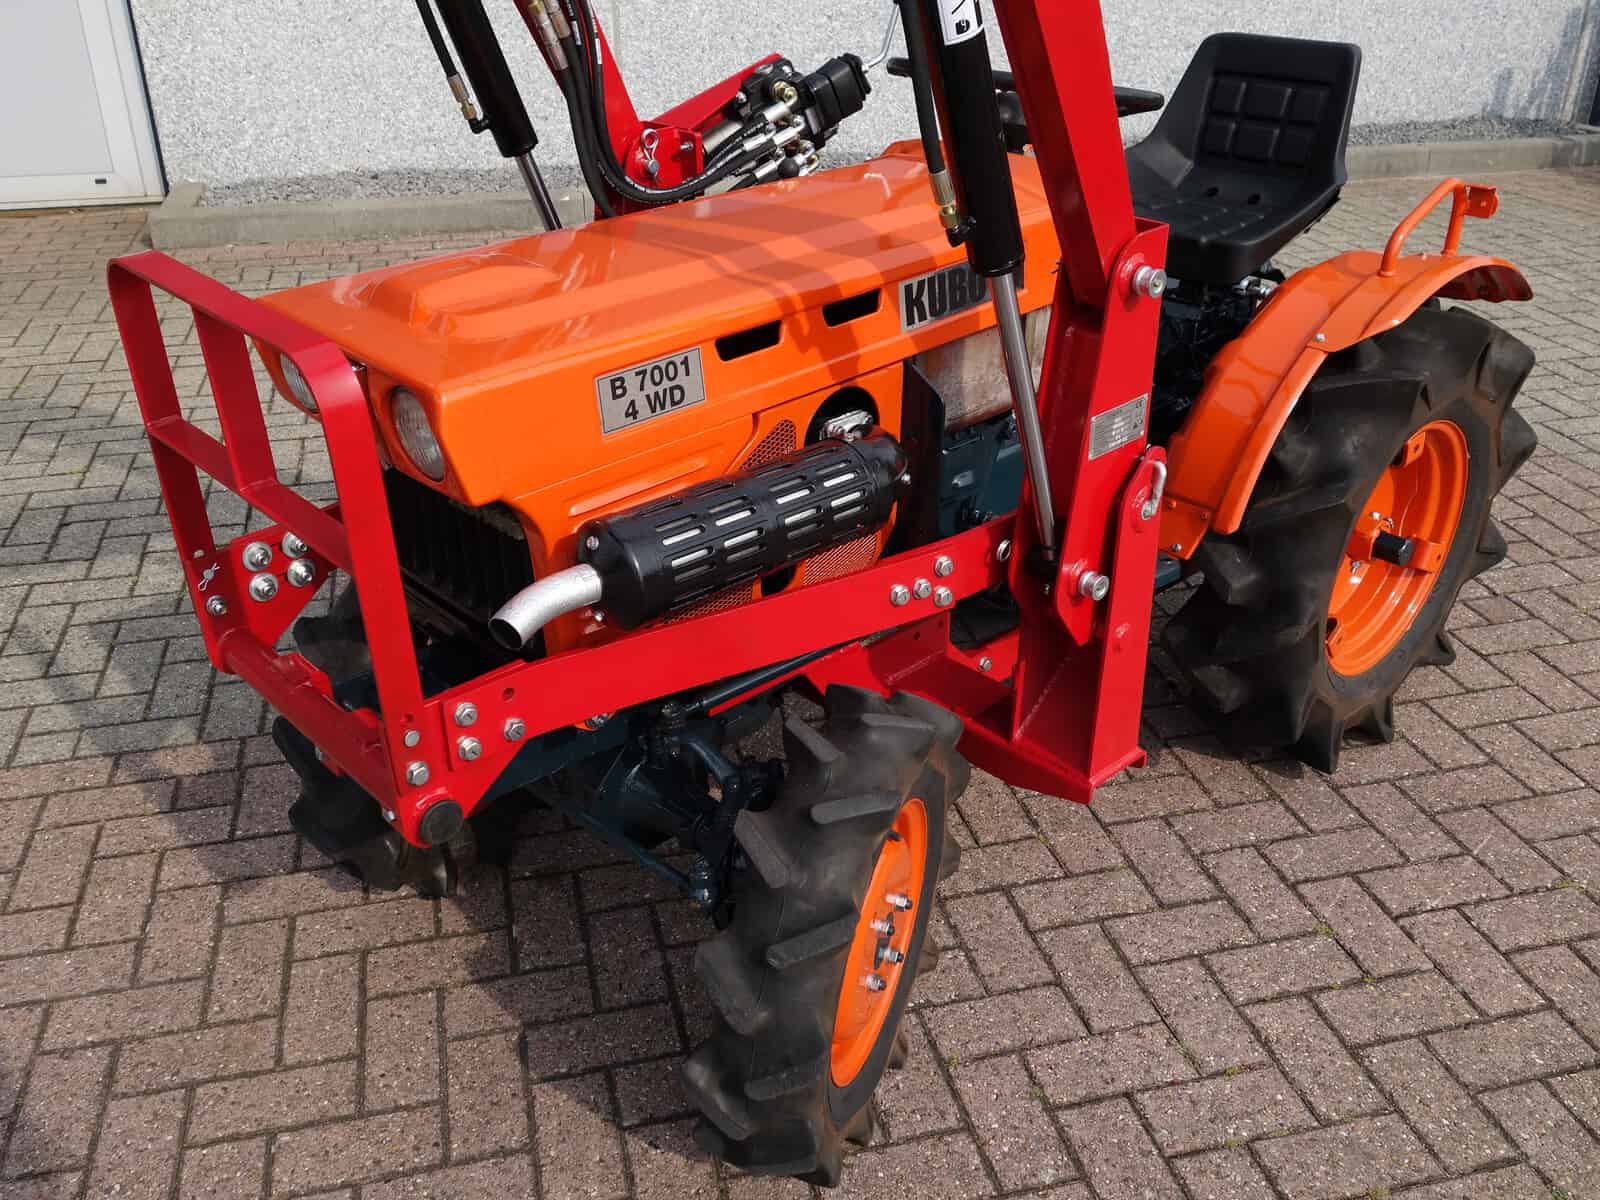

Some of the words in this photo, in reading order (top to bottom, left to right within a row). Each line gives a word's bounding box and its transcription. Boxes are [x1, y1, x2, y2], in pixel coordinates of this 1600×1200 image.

[903, 264, 989, 327] KUBO
[609, 376, 628, 401] B
[634, 355, 690, 392] 7001
[624, 399, 639, 421] 4
[645, 384, 686, 414] WD
